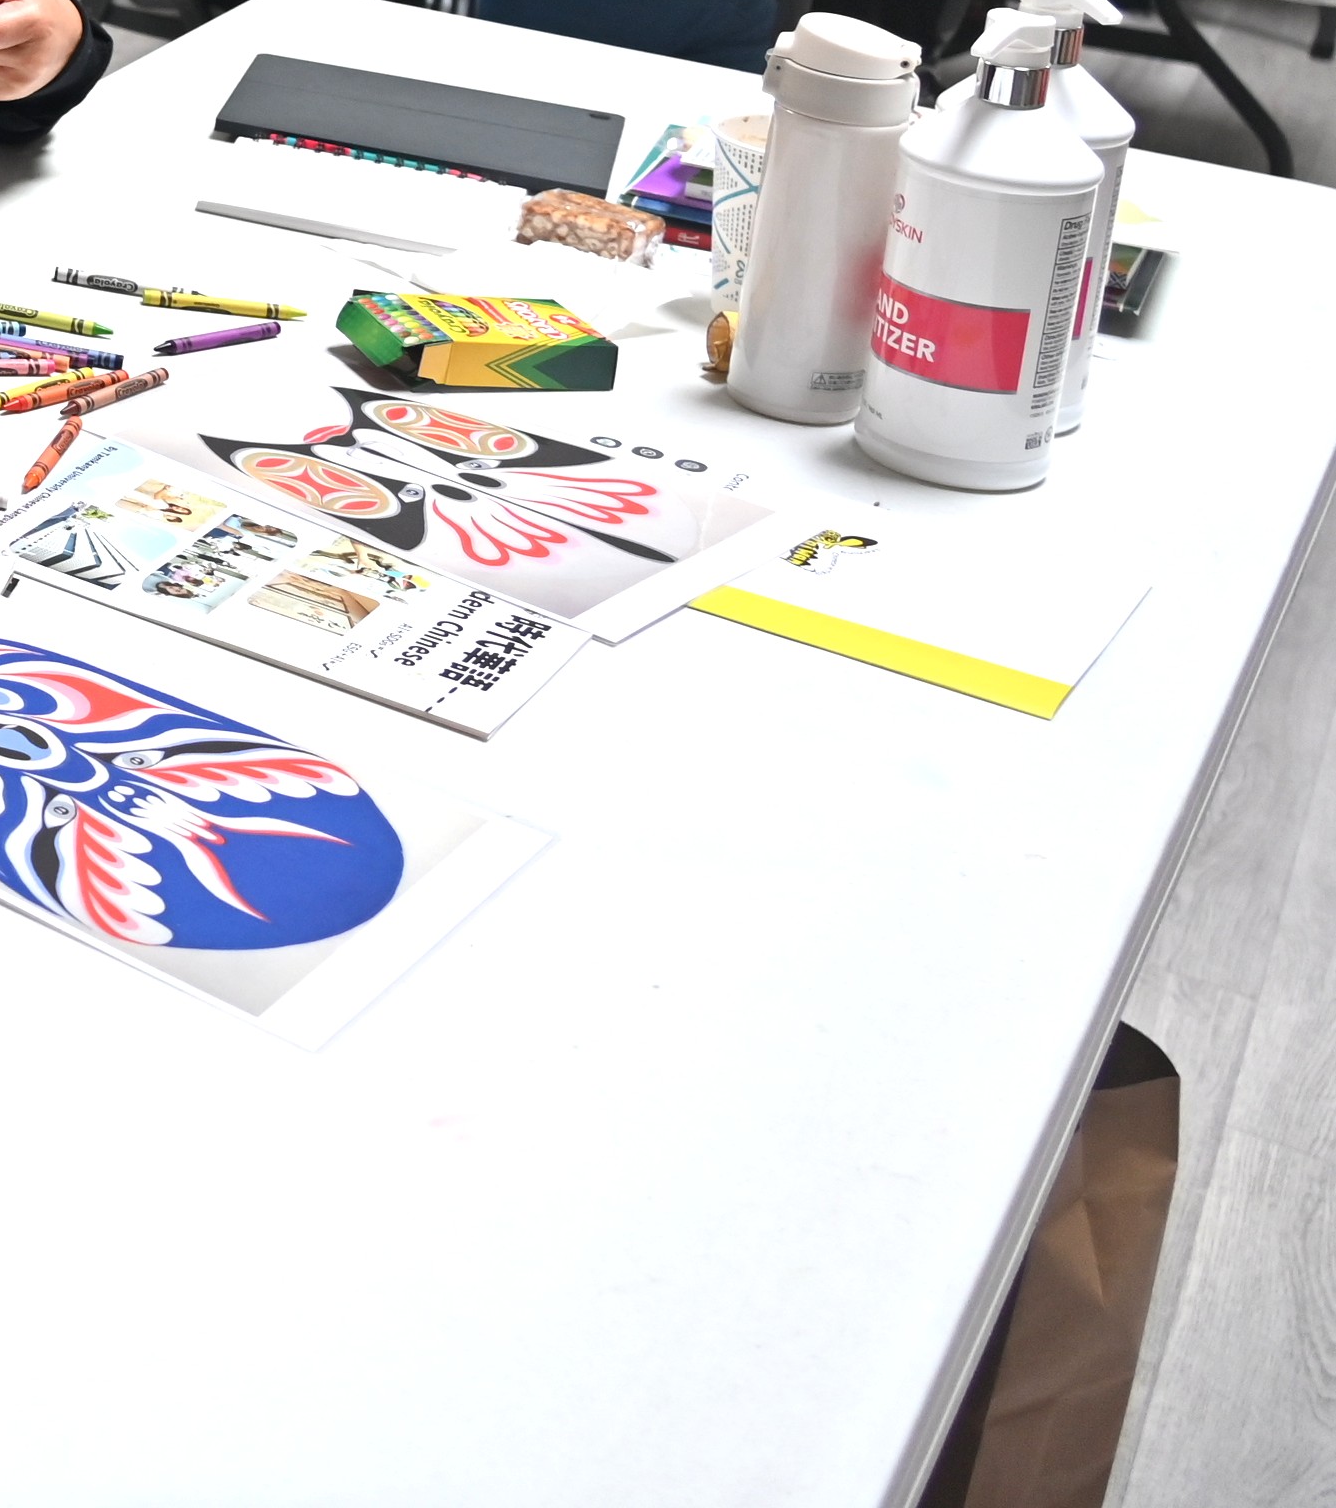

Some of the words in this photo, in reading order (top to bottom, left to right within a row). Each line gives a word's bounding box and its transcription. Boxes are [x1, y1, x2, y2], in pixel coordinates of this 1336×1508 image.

[93, 277, 136, 293] Crayola
[419, 297, 467, 334] Crayola
[502, 300, 569, 340] CRAYONS
[75, 450, 111, 472] Tamkang
[45, 468, 84, 494] University
[22, 491, 52, 511] Chinese
[393, 620, 465, 667] Chinese
[439, 614, 553, 691] 時代華語
